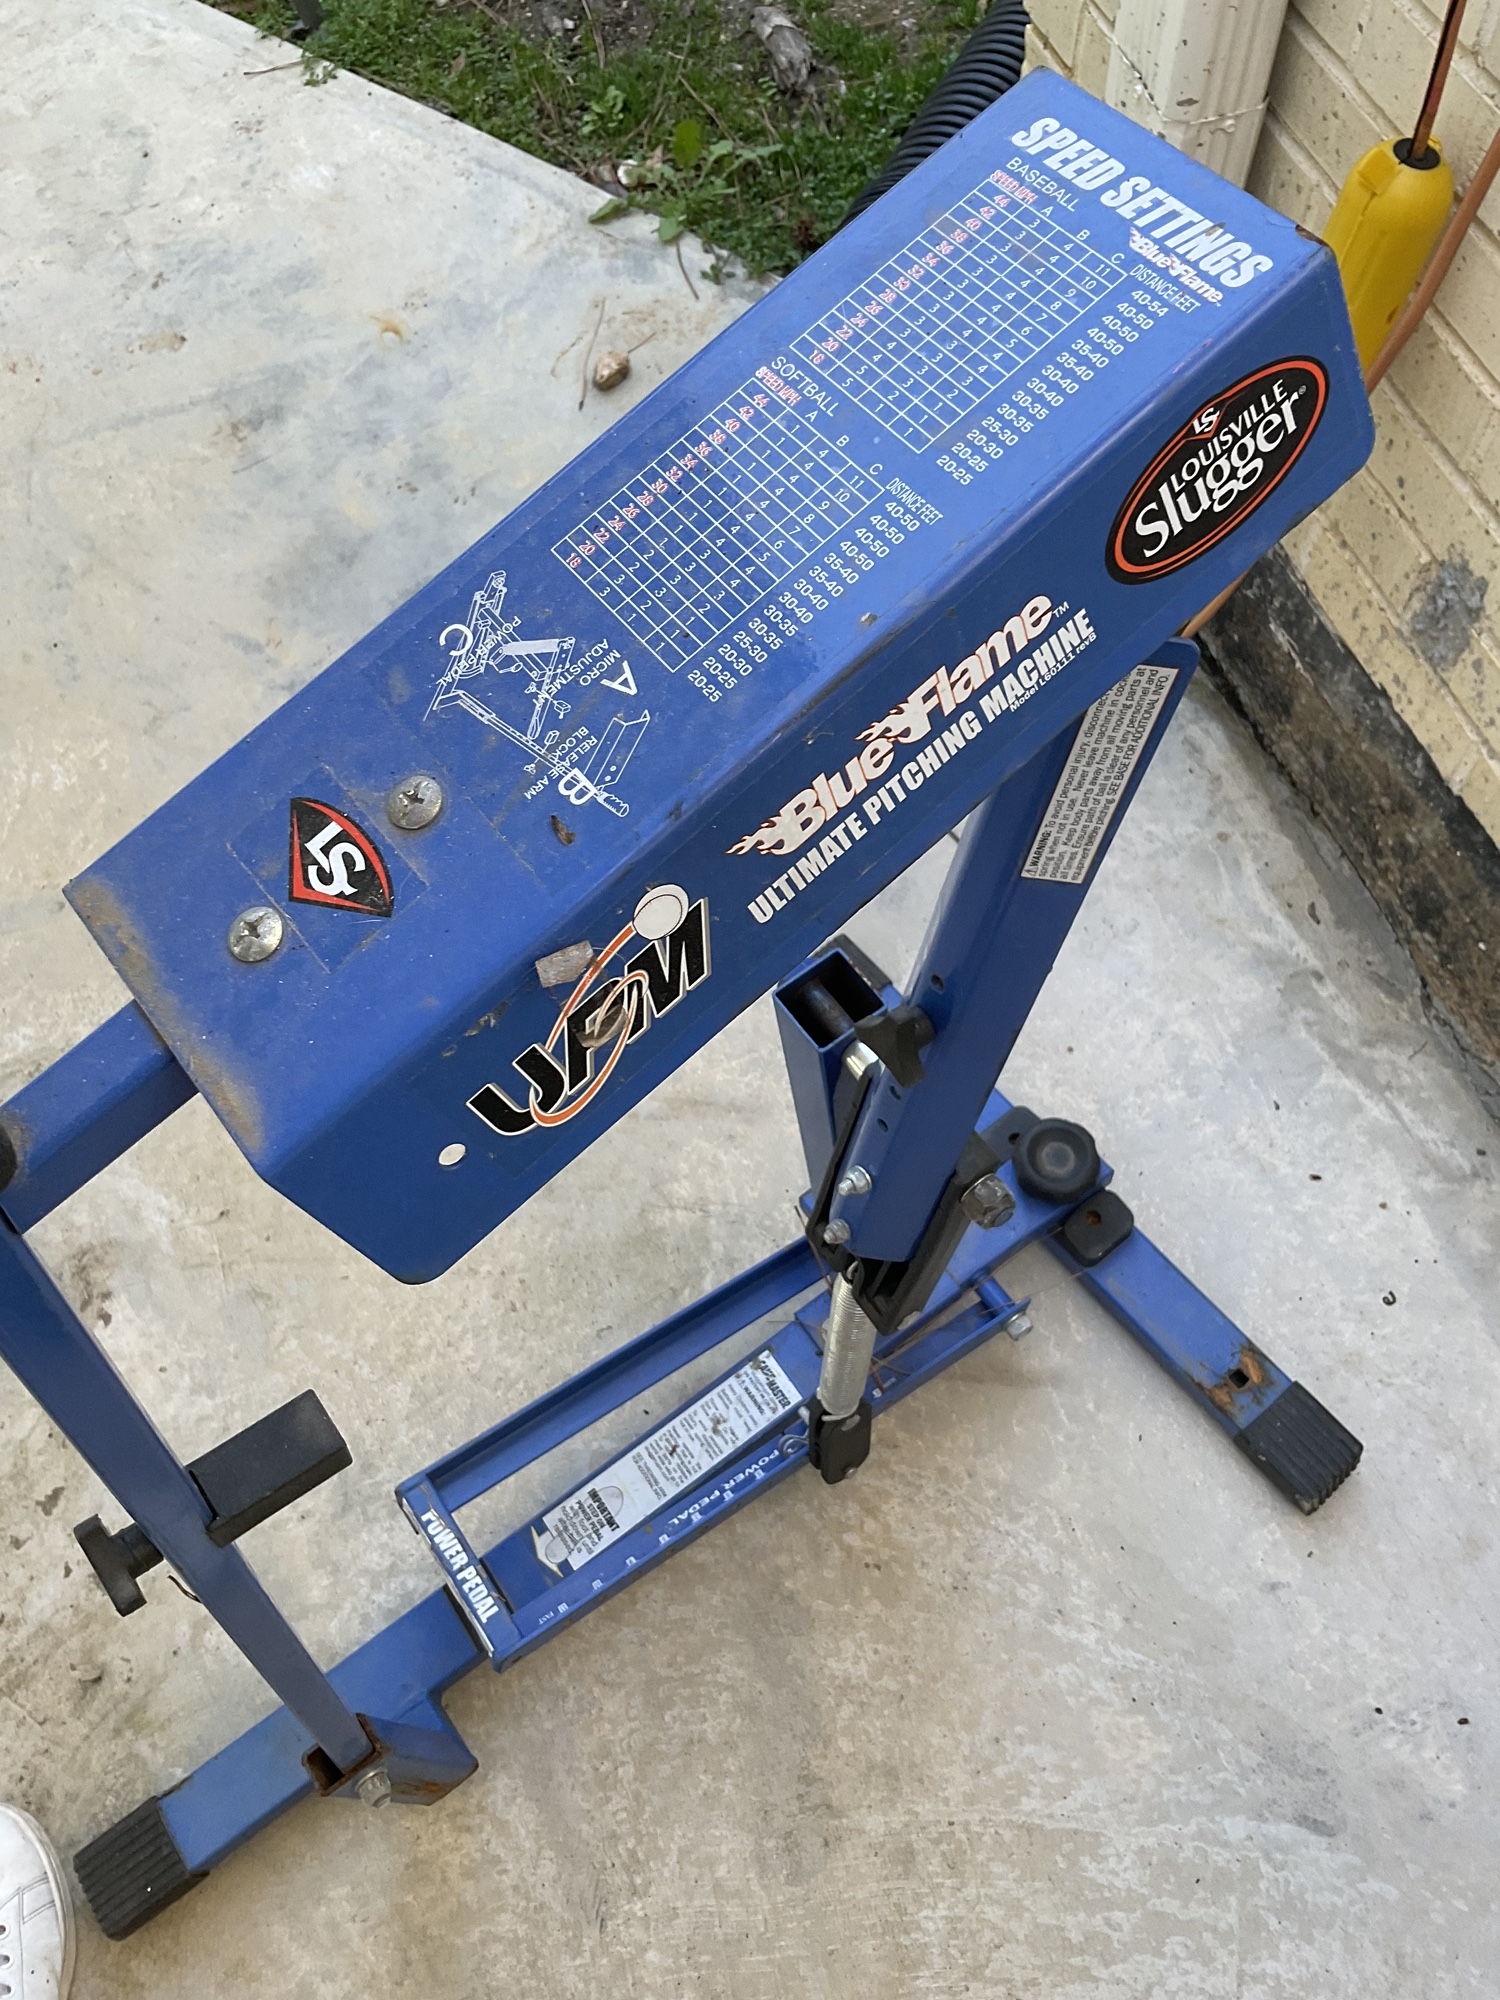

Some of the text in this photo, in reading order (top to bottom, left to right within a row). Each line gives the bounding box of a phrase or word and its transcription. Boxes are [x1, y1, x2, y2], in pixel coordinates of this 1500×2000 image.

[1005, 156, 1079, 212] BASEBALL
[1012, 118, 1273, 287] SPEED SETTINGS
[979, 205, 1154, 330] 42 10 40-50
[989, 169, 1201, 314] SPEED MPH A B C DISTANCE FEET
[993, 194, 1169, 317] 44 11 40-54
[1130, 227, 1223, 303] Blue Flame
[935, 240, 1110, 368] 36 35-40
[965, 217, 1140, 343] 40 40-50
[907, 264, 1080, 394] 32 30-40
[921, 252, 1095, 381] 34 35-40
[1087, 327, 1125, 356] 40-50
[771, 356, 839, 417] SOFTBALL
[849, 312, 1019, 446] 24 25-30
[864, 300, 1035, 433] 26 30-35
[878, 288, 1050, 420] 28 30-35
[808, 349, 974, 485] 18 20-25
[821, 336, 989, 472] 20 20-25
[835, 324, 1004, 459] 22 20-30
[1026, 377, 1065, 407] 30-40
[753, 393, 921, 532] 44 11 40-50
[754, 366, 944, 526] SPEED MPH A B C DISTANCE FEET
[1170, 379, 1288, 493] LOUISVILLE
[724, 418, 890, 558] 40 40-50
[738, 405, 905, 545] 42 10 40-50
[1135, 392, 1300, 558] Slugger
[665, 465, 829, 611] 32 30-40
[679, 453, 844, 598] 34 35-40
[694, 441, 860, 584] 36 35-40
[607, 514, 768, 663] 24 25-30
[621, 502, 784, 650] 26 30-35
[636, 490, 799, 637] 28 30-35
[839, 541, 875, 571] 40-50
[565, 552, 723, 703] 18 20-25
[578, 539, 738, 689] 20 20-25
[592, 527, 753, 676] 22 20-30
[778, 591, 814, 624] 30-40
[436, 615, 522, 687] POWER PEDAL
[439, 624, 473, 656] C
[533, 639, 609, 709] ADJUSTMENT
[579, 650, 621, 687] MICRO
[1135, 667, 1148, 678] at
[600, 660, 638, 695] A
[1010, 685, 1039, 712] Model
[1039, 653, 1076, 686] L60111
[1124, 678, 1142, 702] parts
[1125, 686, 1152, 730] personnel
[1144, 668, 1160, 686] and
[549, 726, 589, 761] BLOCK
[745, 738, 895, 855] Blue
[878, 595, 1054, 744] Flame
[1071, 769, 1090, 793] Never
[1081, 746, 1100, 768] leave
[1093, 709, 1116, 746] machine
[1106, 734, 1118, 746] all
[1111, 702, 1134, 734] moving
[1118, 728, 1134, 745] any
[1122, 743, 1139, 761] FOR
[1130, 697, 1161, 744] ADDITIONAL
[524, 735, 598, 800] RELEASE ARM
[558, 768, 598, 805] B
[747, 608, 1094, 924] ULTIMATE PITCHING MACHINE
[1088, 766, 1105, 787] away
[1094, 746, 1113, 766] from
[1105, 753, 1121, 775] clear
[1106, 780, 1122, 797] SEE
[1112, 760, 1131, 781] BASE
[1028, 829, 1053, 867] WARNING:
[1050, 799, 1066, 820] avoid
[1059, 764, 1080, 799] personal
[1069, 808, 1087, 827] body
[1079, 787, 1095, 808] parts
[304, 820, 366, 896] LS
[1060, 827, 1078, 847] Keep
[466, 896, 711, 1136] UPM
[765, 1379, 792, 1410] MASTER
[722, 1449, 780, 1490] POWER
[575, 1499, 593, 1522] POWER
[587, 1487, 621, 1532] IMPORTANT
[668, 1489, 721, 1526] PEDAL
[456, 1565, 499, 1623] PEDAL
